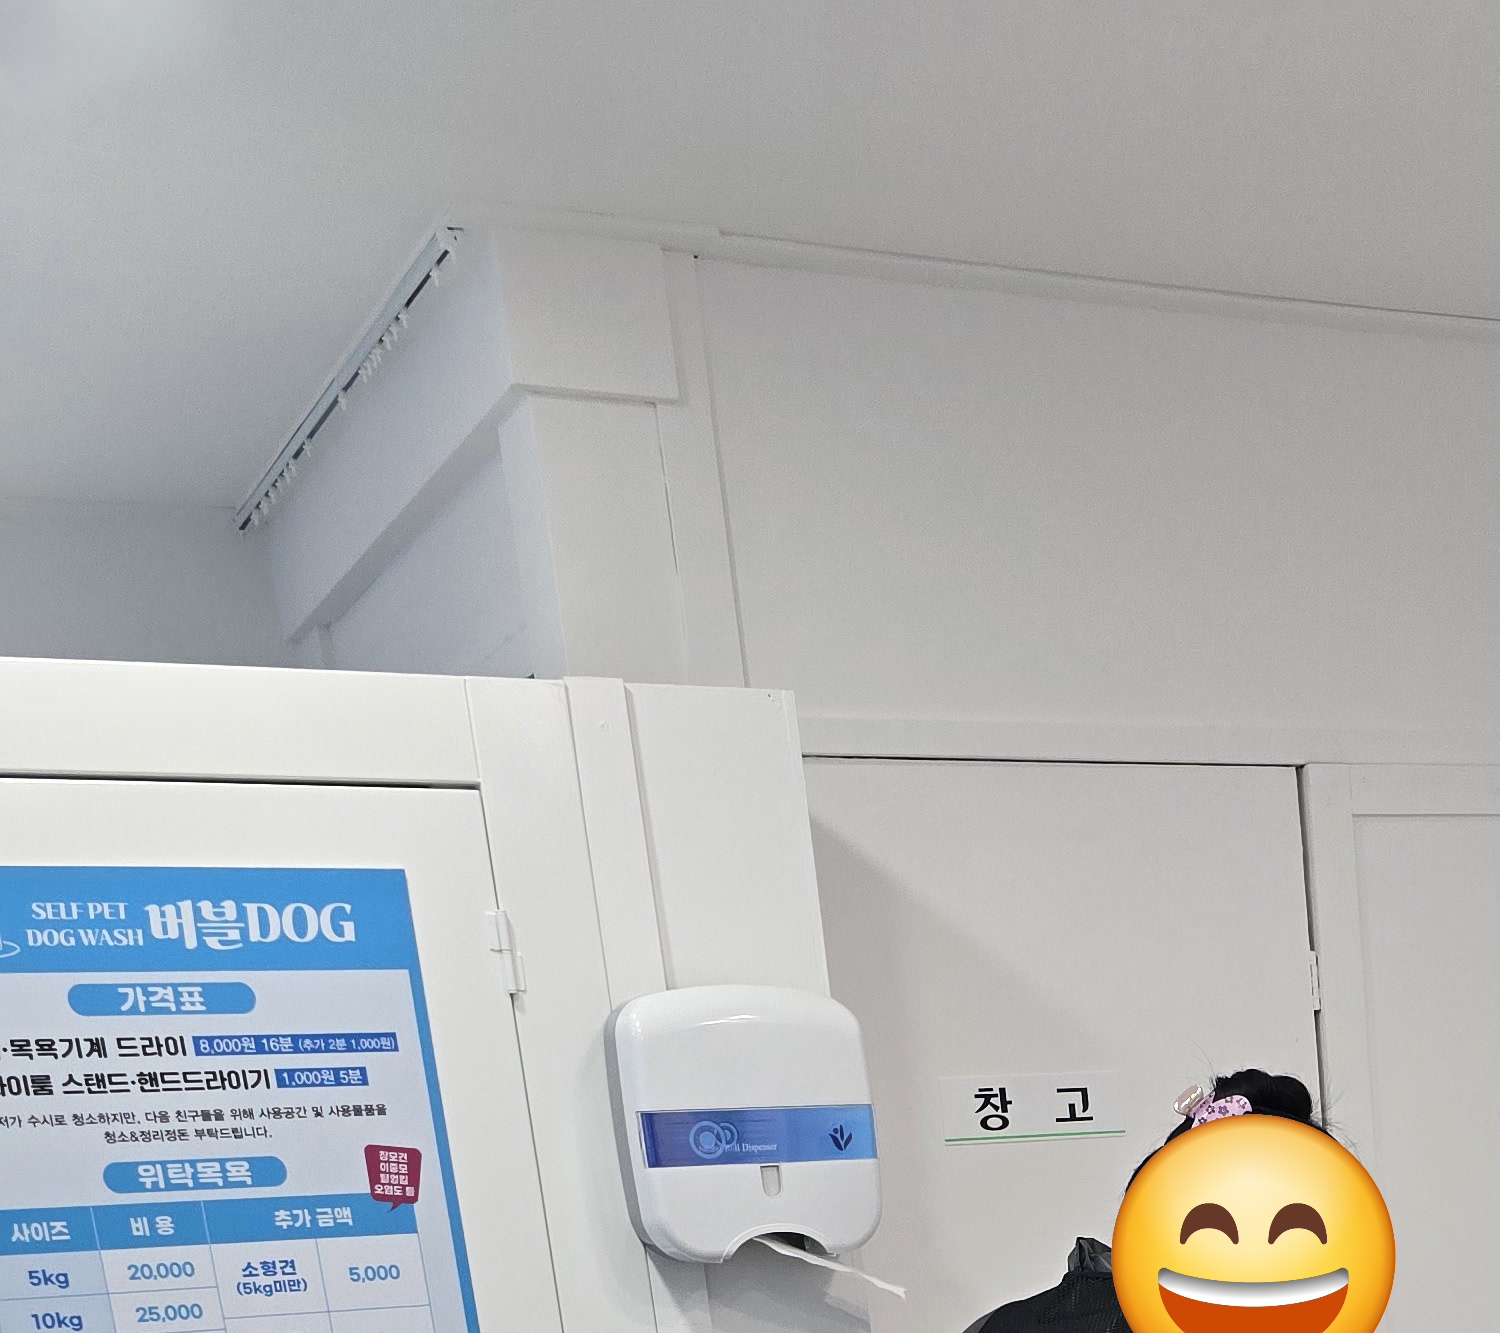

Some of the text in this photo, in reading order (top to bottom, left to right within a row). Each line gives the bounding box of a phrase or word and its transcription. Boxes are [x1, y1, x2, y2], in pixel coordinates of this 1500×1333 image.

[31, 901, 128, 920] SELF PET
[144, 899, 356, 951] 버블DOG
[26, 928, 144, 947] DOG WASH
[117, 986, 206, 1012] 가격표
[116, 1035, 187, 1058] 드라이
[261, 1036, 294, 1053] 16분
[298, 1037, 325, 1052] (추가
[329, 1037, 347, 1051] 2분
[339, 1069, 362, 1085] 5분
[27, 1114, 68, 1127] 수시로
[72, 1111, 141, 1126] 청소하지만,
[145, 1110, 170, 1125] 다음
[175, 1109, 225, 1123] 친구들을
[230, 1107, 255, 1121] 위해
[259, 1106, 307, 1120] 사용공간
[311, 1105, 324, 1118] 및
[104, 1125, 273, 1144] 청소&정리정돈 부탁드립니다.
[138, 1160, 253, 1190] 위탁목욕
[274, 1206, 353, 1229] 추가 금액
[11, 1219, 71, 1244] 사이즈
[127, 1261, 196, 1282] 20,000
[241, 1258, 297, 1278] 소형견
[348, 1264, 401, 1284] 5,000
[27, 1269, 70, 1289] 5kg
[236, 1278, 308, 1297] (5kg미만)
[31, 1312, 84, 1332] 10kg
[135, 1303, 204, 1324] 25,000
